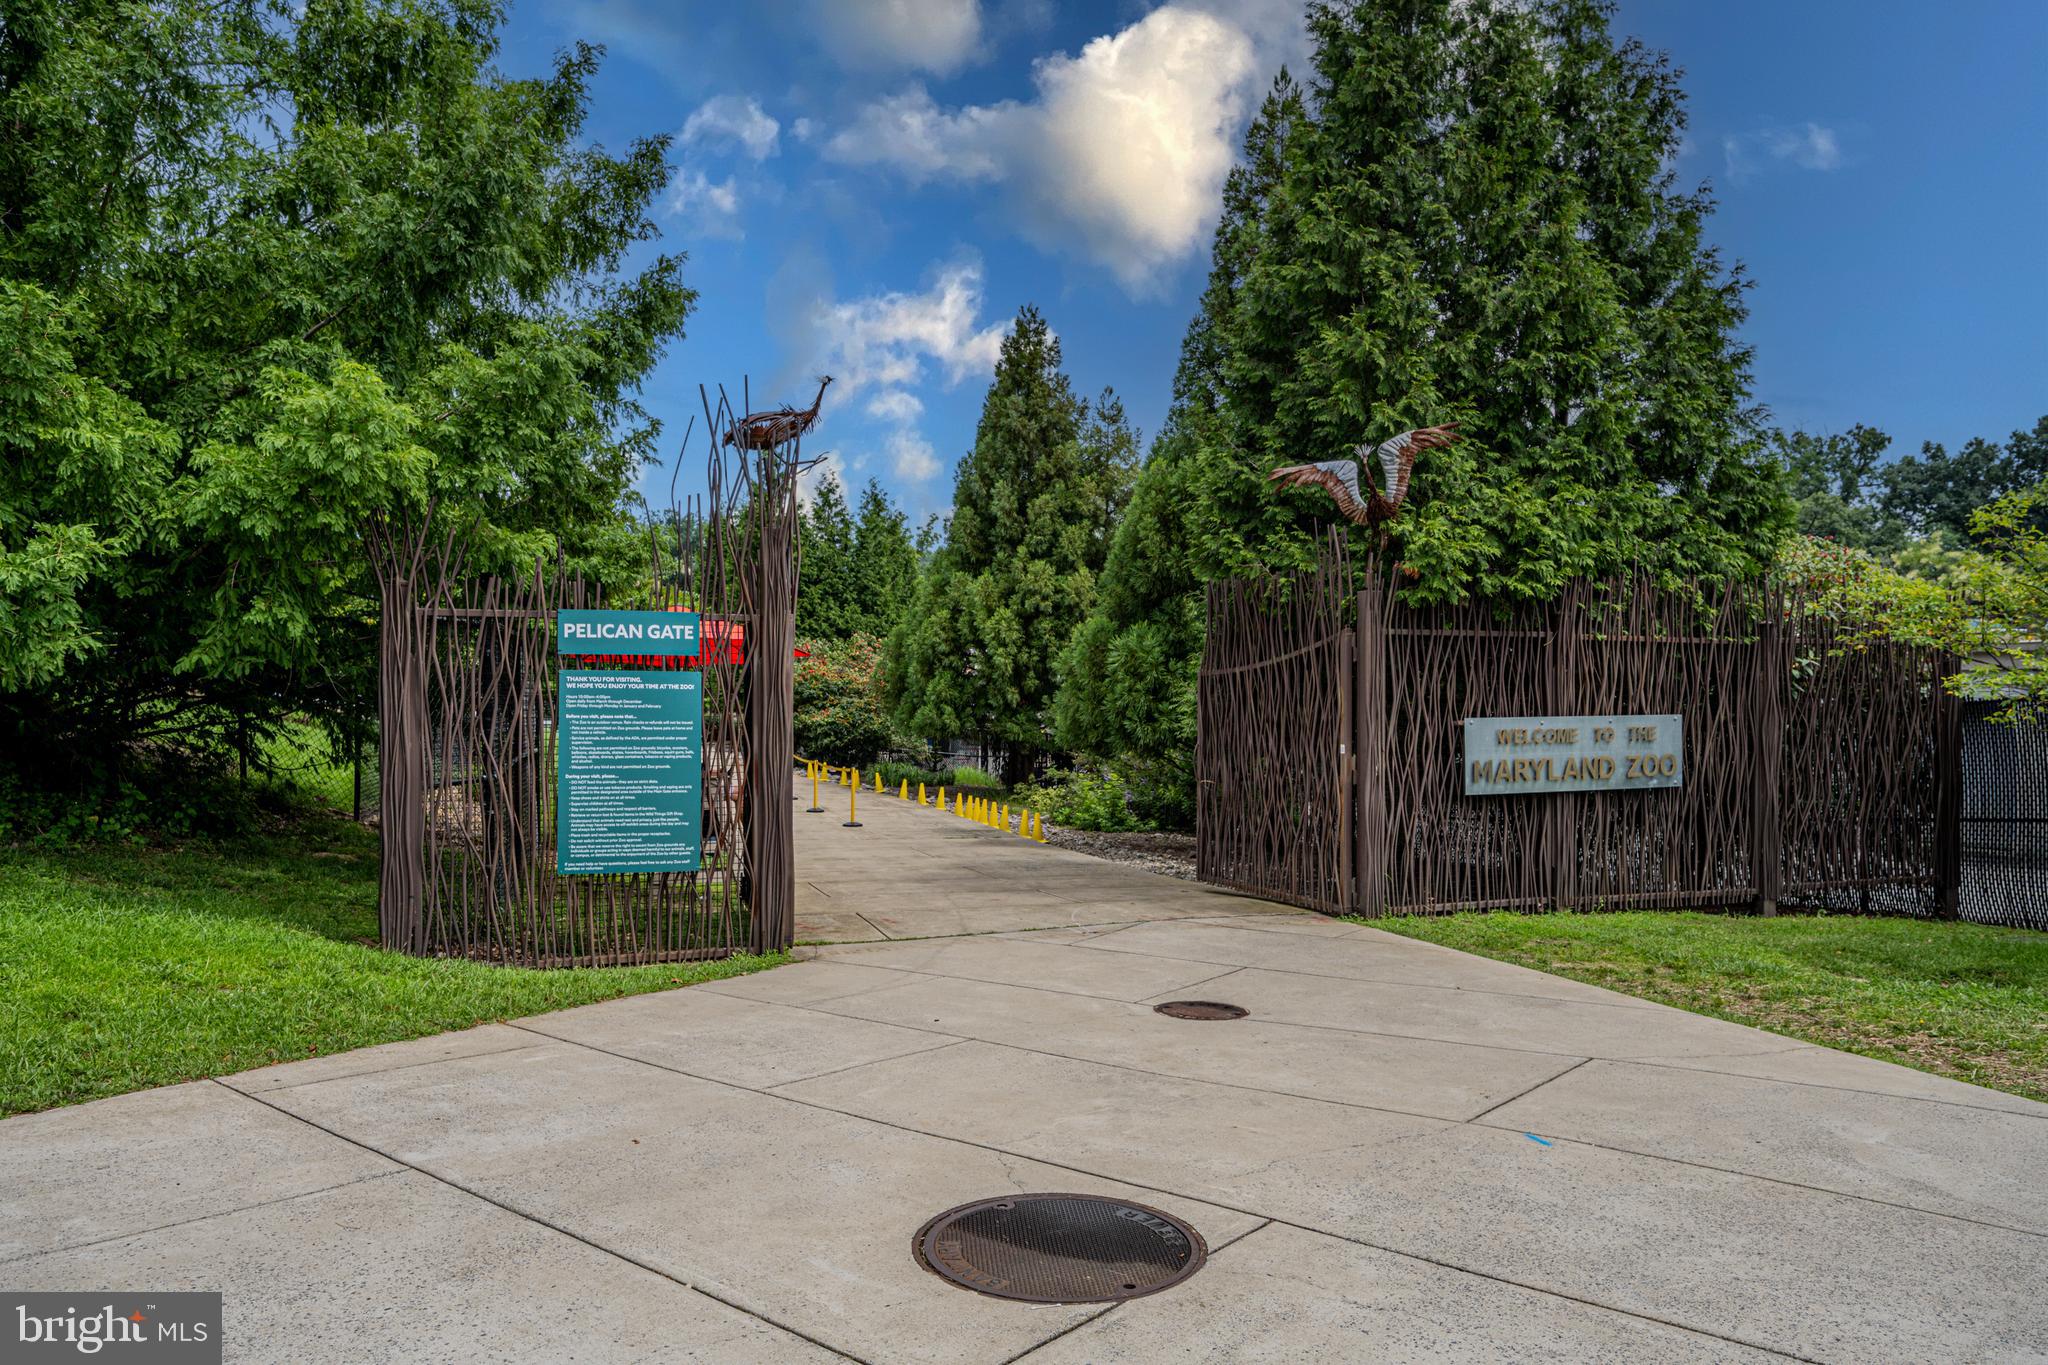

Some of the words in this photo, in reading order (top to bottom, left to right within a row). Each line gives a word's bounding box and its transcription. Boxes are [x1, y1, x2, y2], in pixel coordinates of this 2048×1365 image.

[563, 623, 643, 638] PELICAN
[647, 624, 694, 639] GATE
[1497, 727, 1579, 745] WELCOME
[1594, 726, 1615, 744] TO
[1628, 725, 1656, 744] THE
[1472, 756, 1616, 784] MARYLAND
[1625, 753, 1678, 779] ZOO
